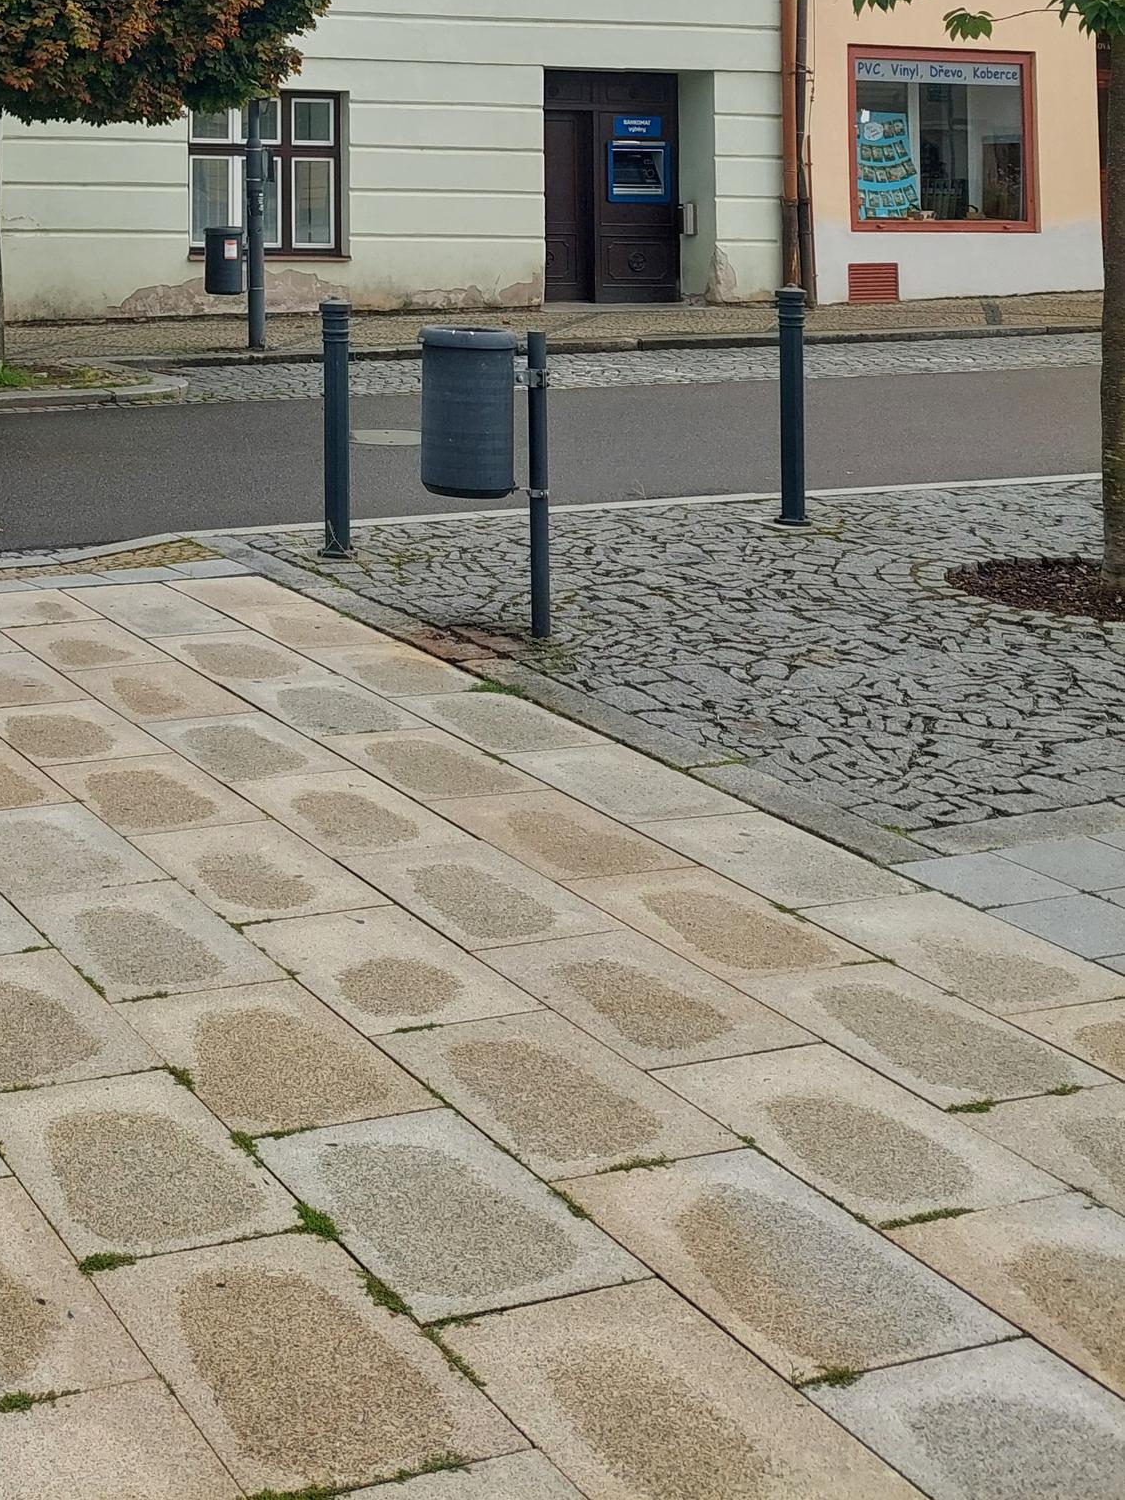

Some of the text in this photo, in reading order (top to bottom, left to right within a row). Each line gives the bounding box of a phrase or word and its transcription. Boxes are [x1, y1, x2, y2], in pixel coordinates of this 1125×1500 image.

[857, 61, 1019, 81] PVC, Vinyl, Dřevo, Koberce
